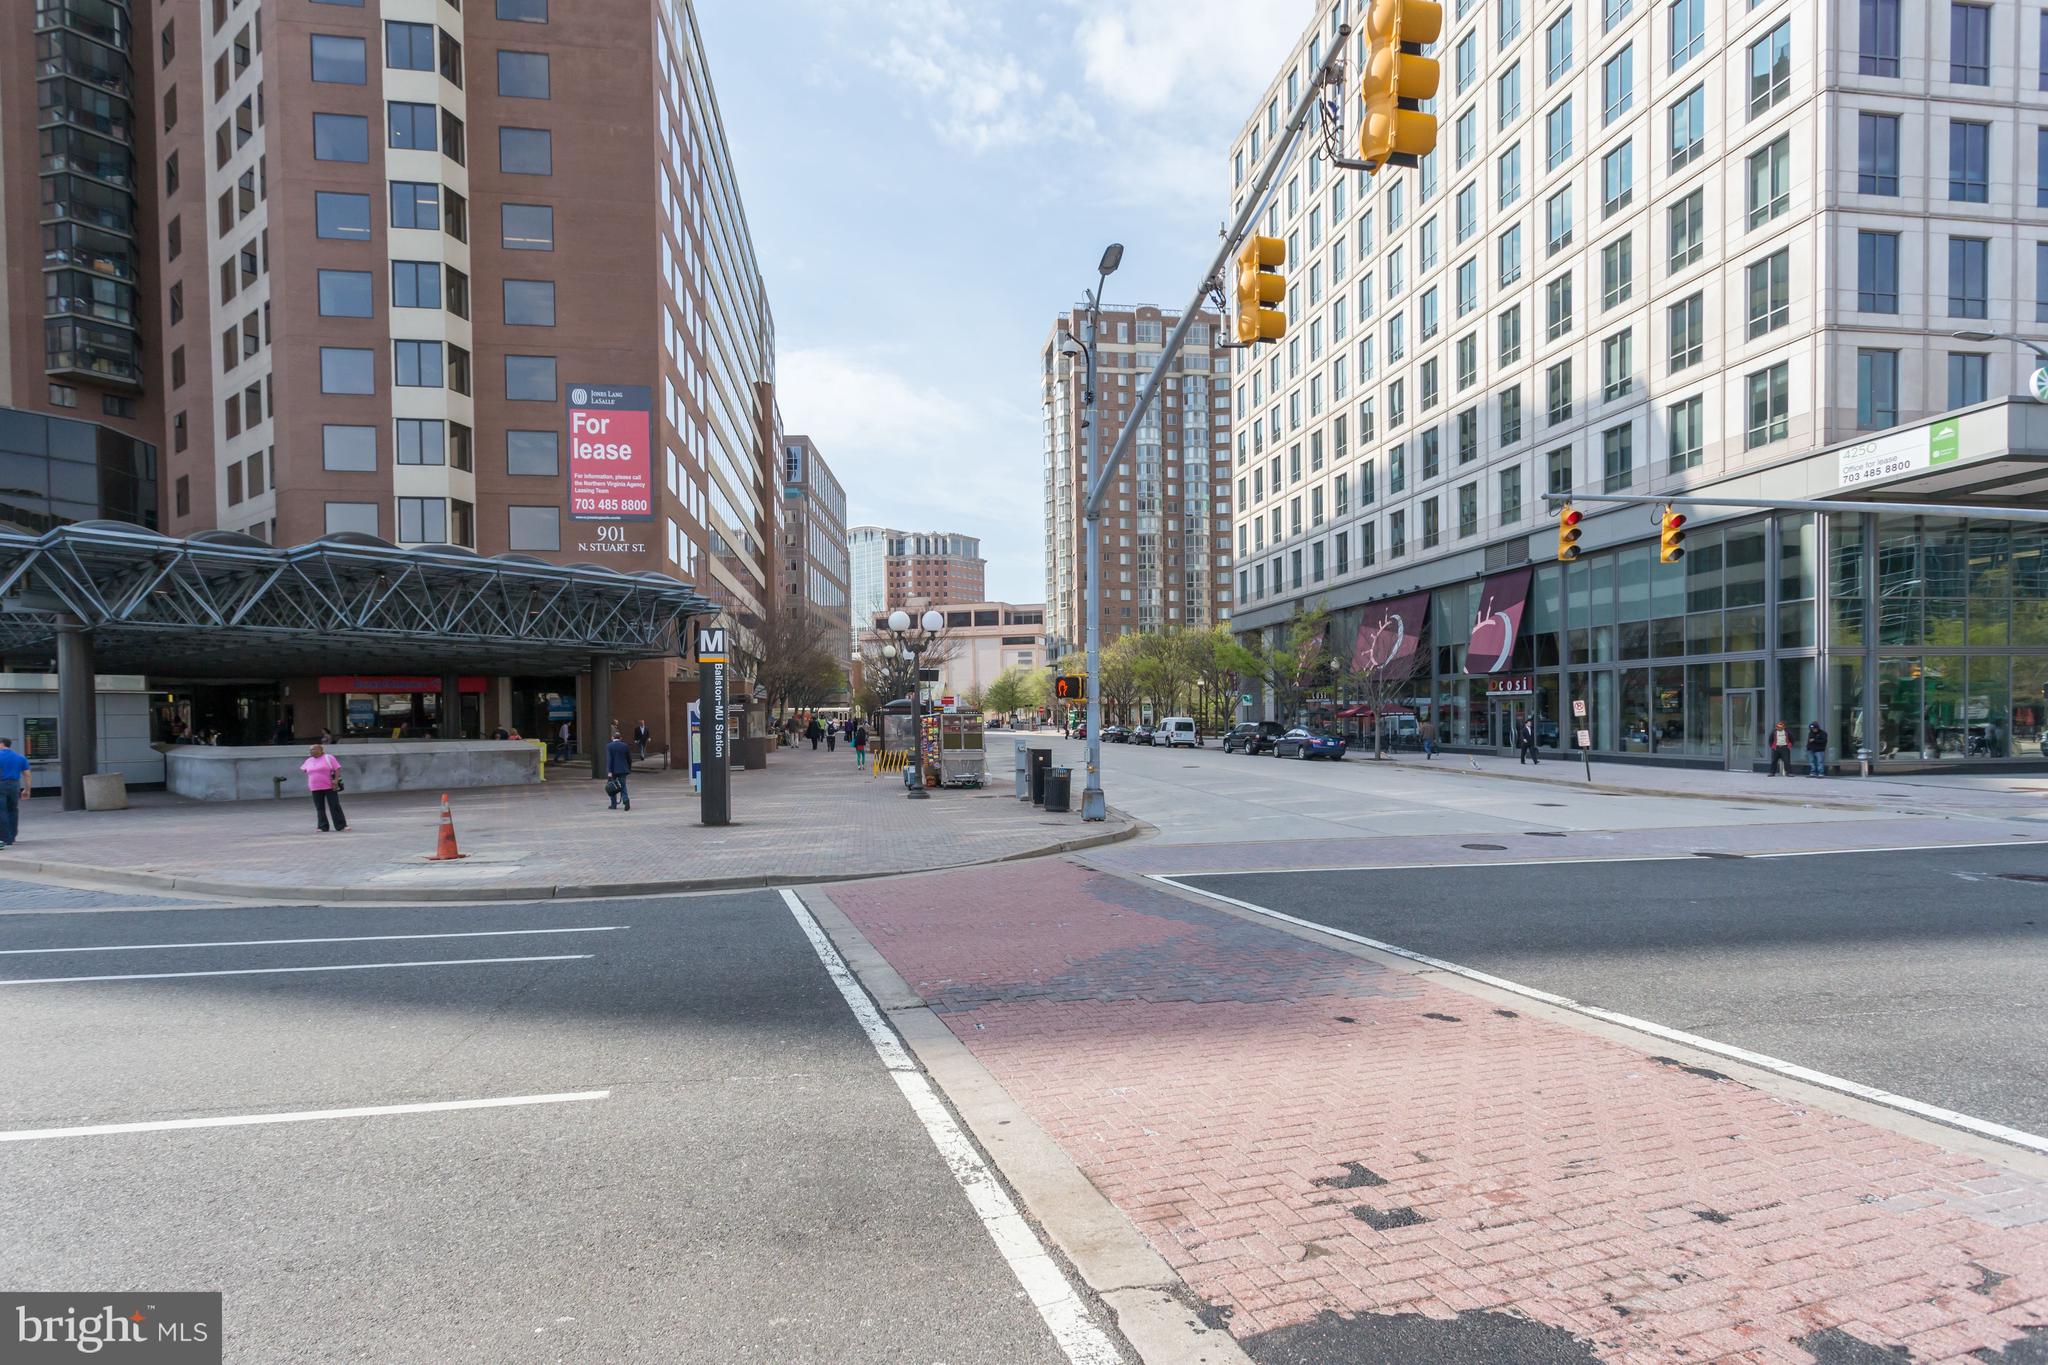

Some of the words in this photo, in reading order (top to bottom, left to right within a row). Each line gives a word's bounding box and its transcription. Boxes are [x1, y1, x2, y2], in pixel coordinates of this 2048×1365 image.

[573, 412, 610, 434] For
[573, 437, 632, 460] lease
[1843, 472, 1860, 484] 703
[1864, 466, 1881, 478] 485
[1885, 459, 1911, 473] 8800
[575, 498, 595, 510] 703
[598, 499, 618, 510] 485
[621, 499, 647, 511] 8800
[597, 525, 625, 542] 901
[589, 543, 630, 552] STUART
[632, 543, 646, 552] ST.
[700, 630, 723, 652] M
[714, 663, 724, 720] Ballston-MU
[715, 725, 725, 758] Station
